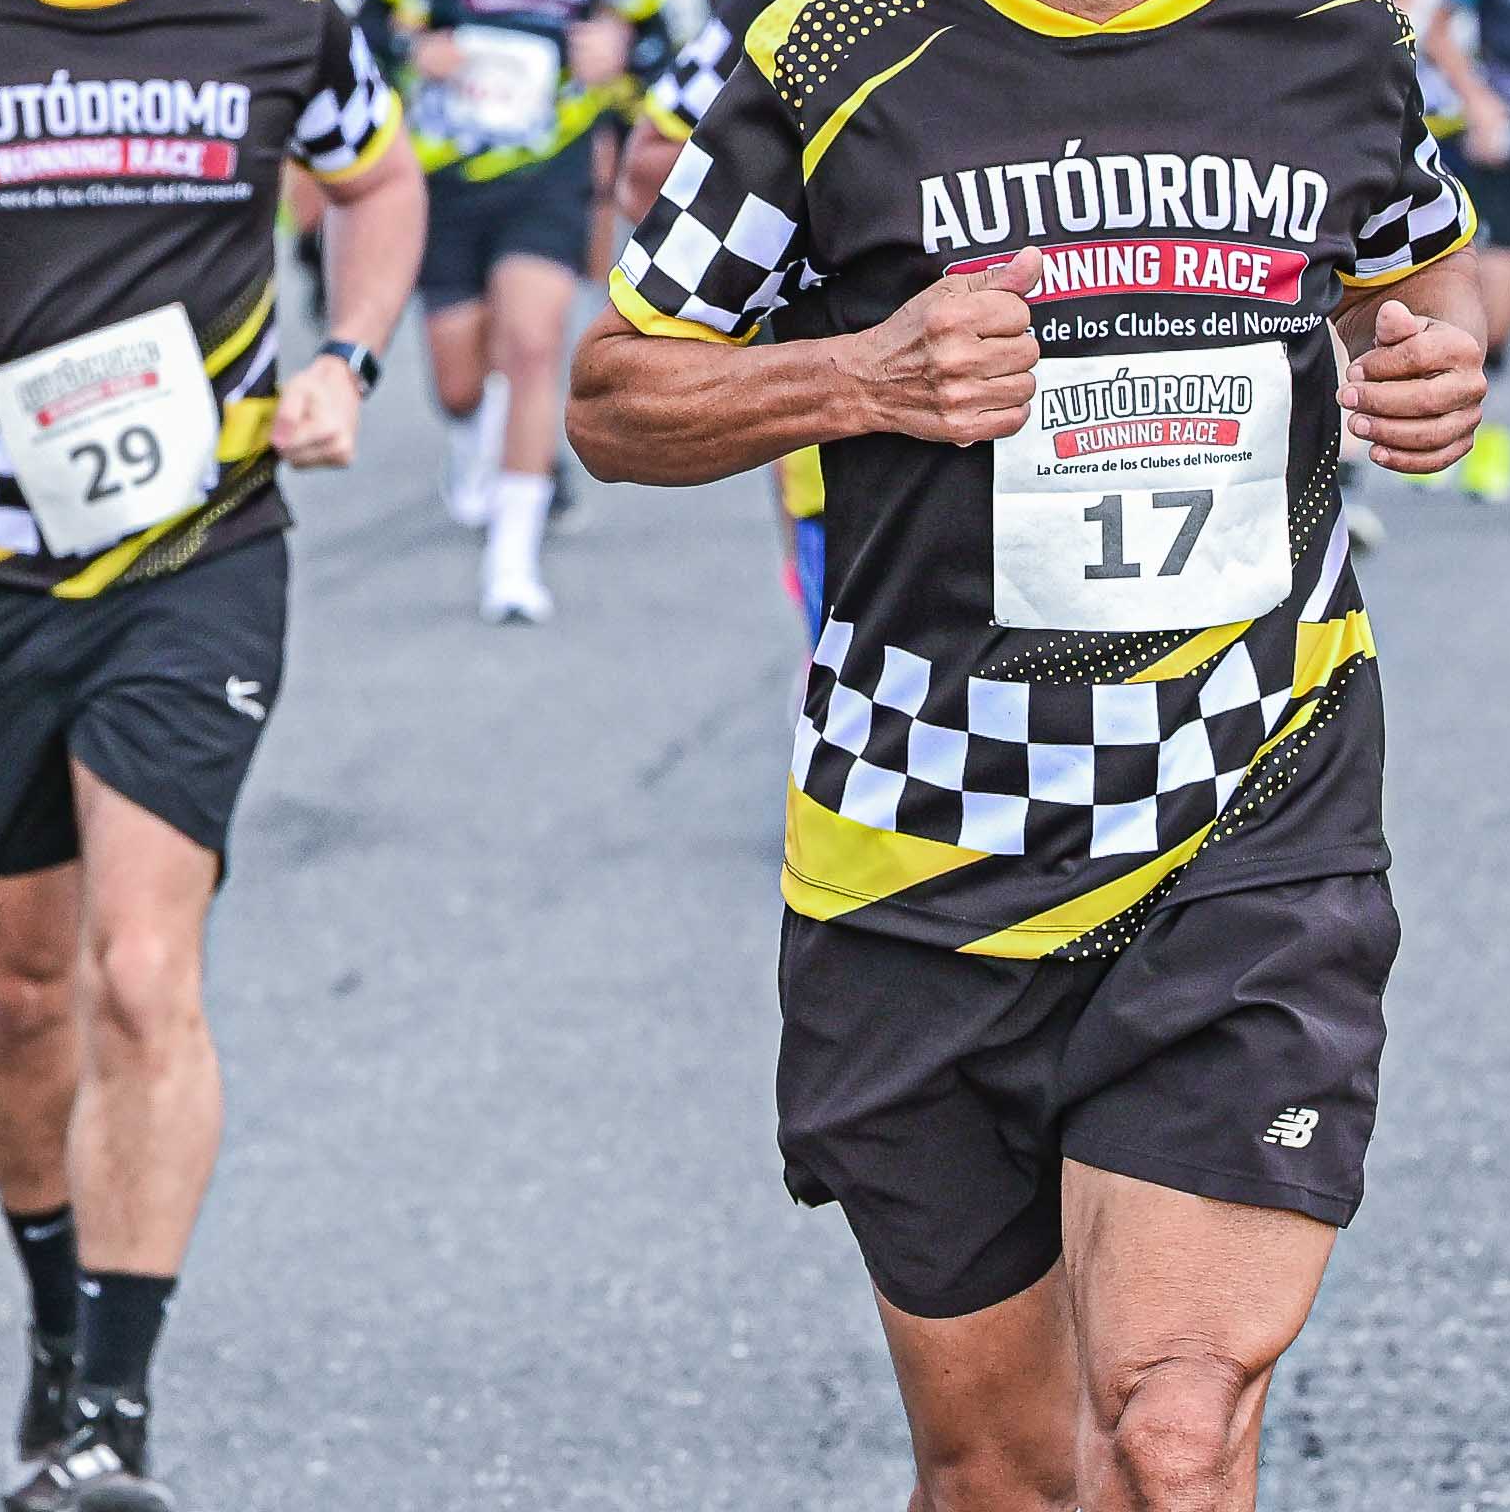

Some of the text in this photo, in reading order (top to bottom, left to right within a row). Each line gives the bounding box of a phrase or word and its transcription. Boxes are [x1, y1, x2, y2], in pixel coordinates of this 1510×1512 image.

[920, 139, 1329, 254] AUTÓDROMO
[987, 245, 1273, 299] NNING RACE
[1042, 317, 1071, 342] de
[1077, 315, 1109, 339] los
[1115, 312, 1197, 337] Clubes
[1201, 311, 1237, 337] del
[1244, 311, 1323, 336] Noroeste
[1041, 367, 1253, 430] AUTÓDROMO
[67, 424, 163, 506] 29
[1036, 450, 1253, 476] La Carrera de los Clubes del Noroeste
[1075, 421, 1220, 454] RUNNING RACE
[1084, 489, 1214, 580] 17
